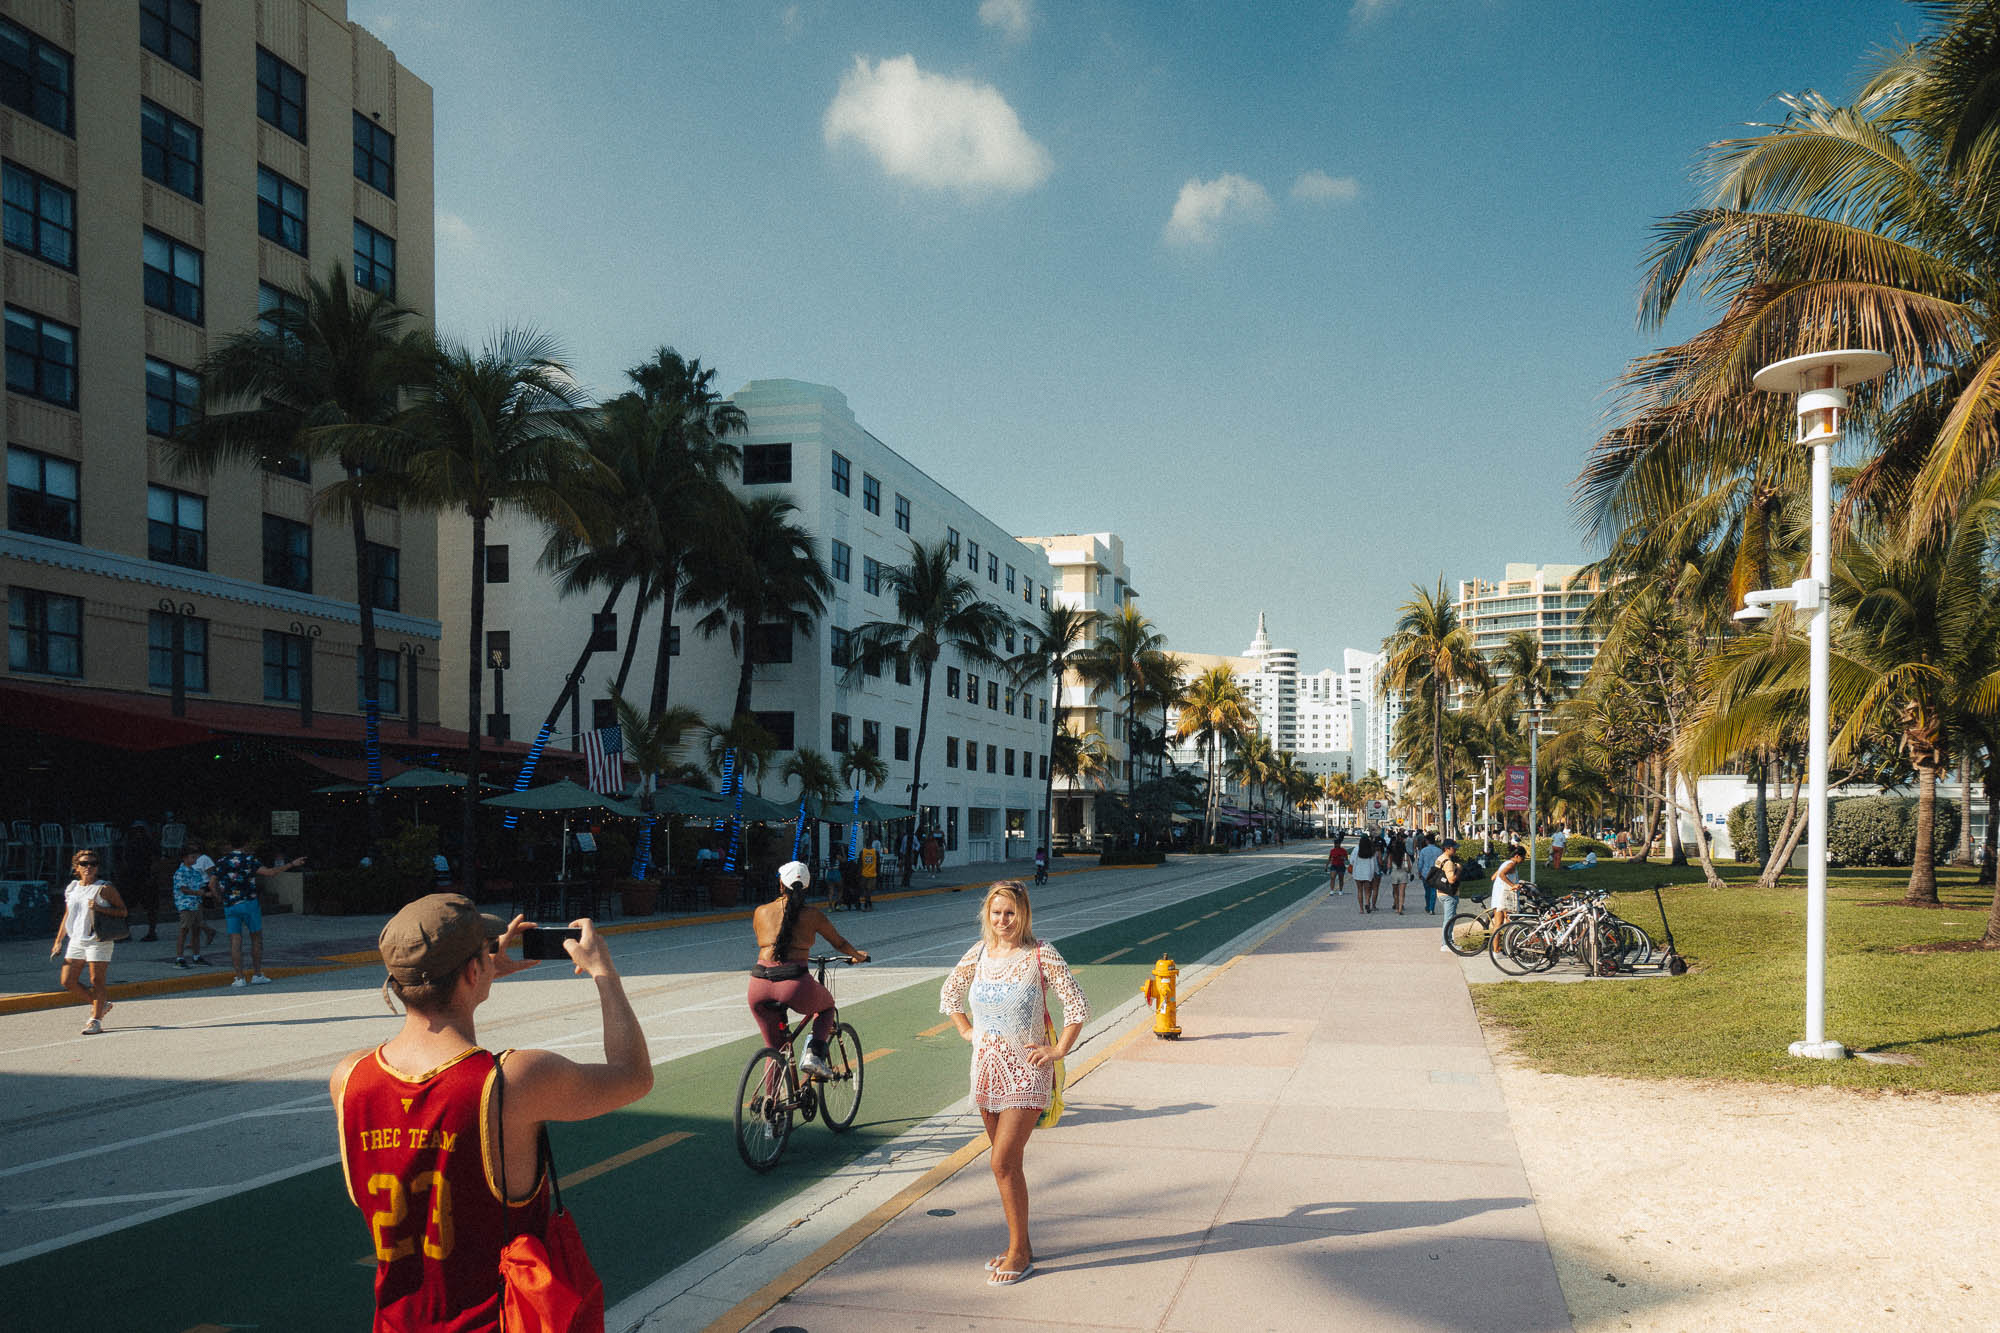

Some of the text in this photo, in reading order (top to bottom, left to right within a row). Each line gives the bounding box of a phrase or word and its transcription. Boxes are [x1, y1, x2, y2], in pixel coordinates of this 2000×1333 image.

[360, 1128, 457, 1152] TREC TEAM
[367, 1171, 455, 1262] 23
